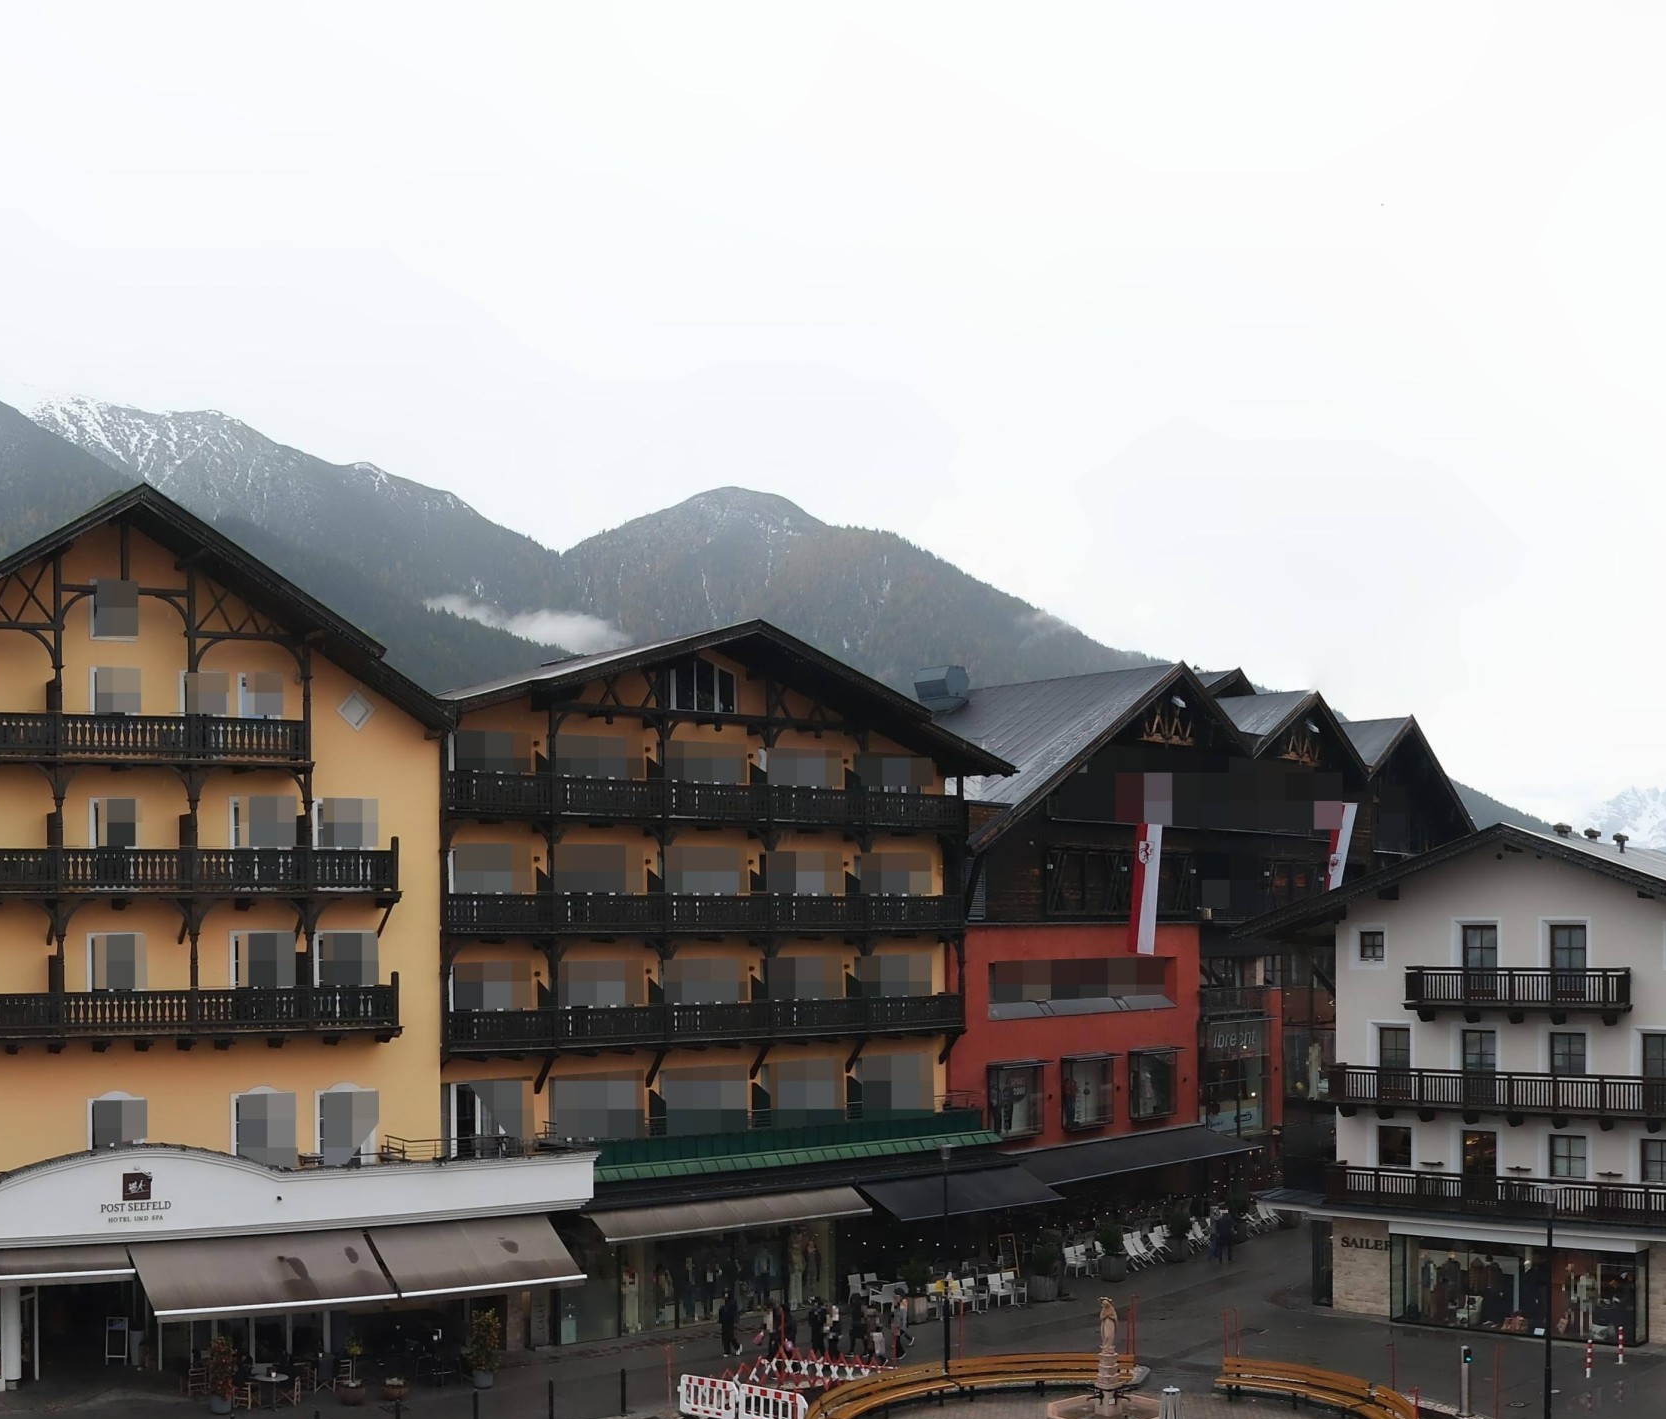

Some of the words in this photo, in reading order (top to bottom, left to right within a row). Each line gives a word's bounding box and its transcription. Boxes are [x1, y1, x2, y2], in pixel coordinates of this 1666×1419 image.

[101, 1203, 125, 1213] POST
[128, 1201, 172, 1212] SEEFELD
[1341, 1236, 1392, 1251] SAILER
